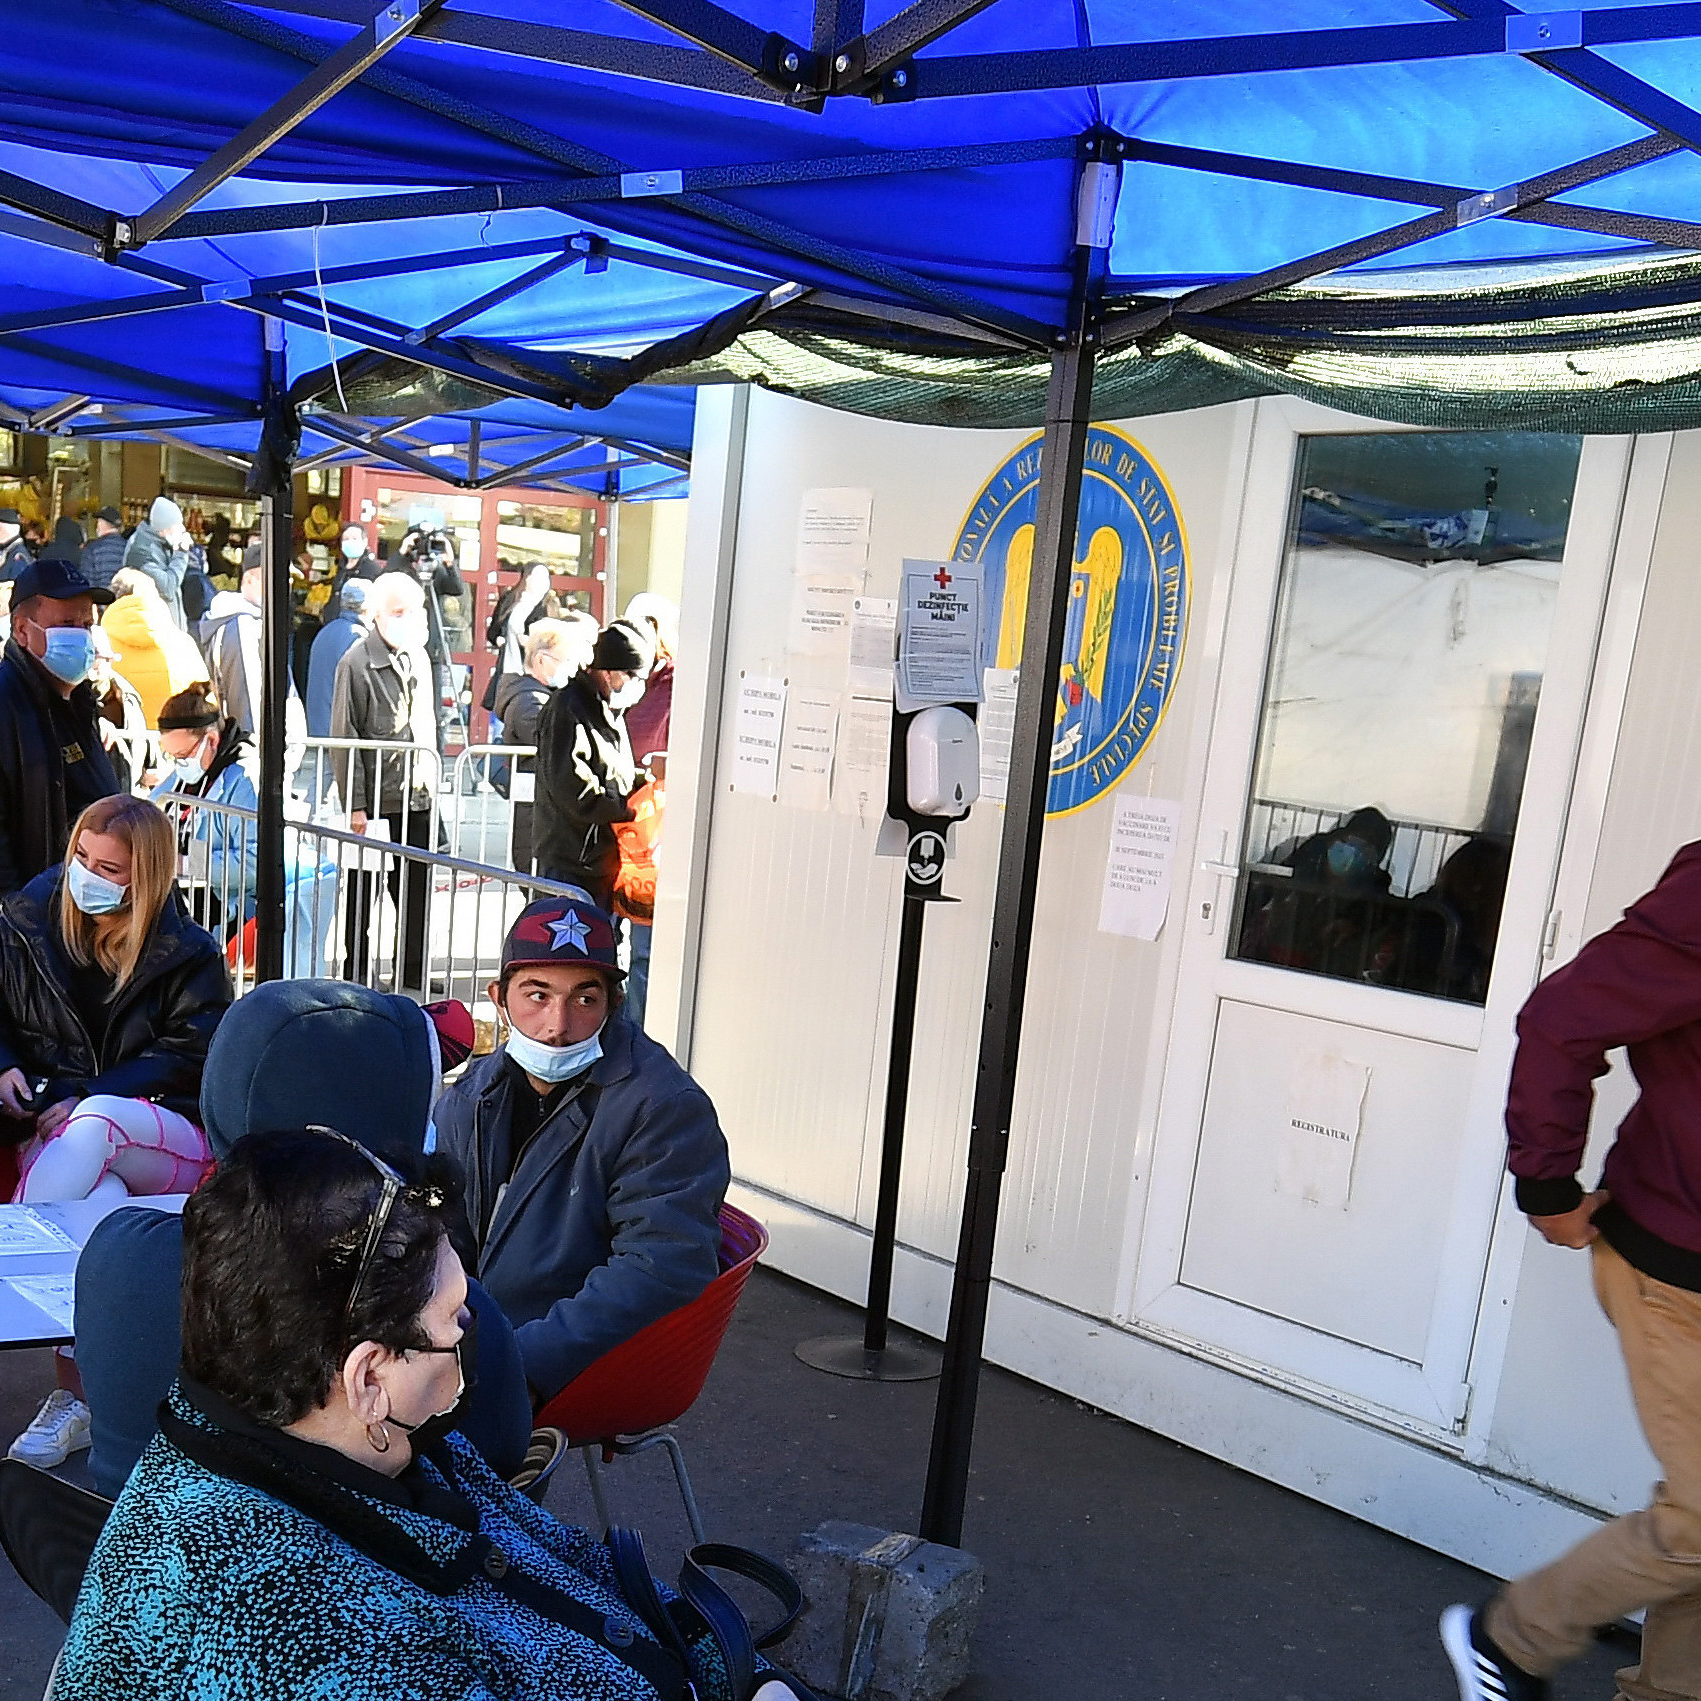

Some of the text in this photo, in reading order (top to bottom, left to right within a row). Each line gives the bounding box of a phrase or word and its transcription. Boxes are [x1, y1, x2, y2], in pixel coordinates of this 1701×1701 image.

[1116, 452, 1138, 483] DE
[1138, 477, 1168, 525] STAT
[929, 592, 957, 600] PUNCT
[1150, 565, 1179, 691] PROBLEME
[1090, 700, 1154, 786] SPECIALE
[1291, 1118, 1350, 1142] REGISTRATURA
